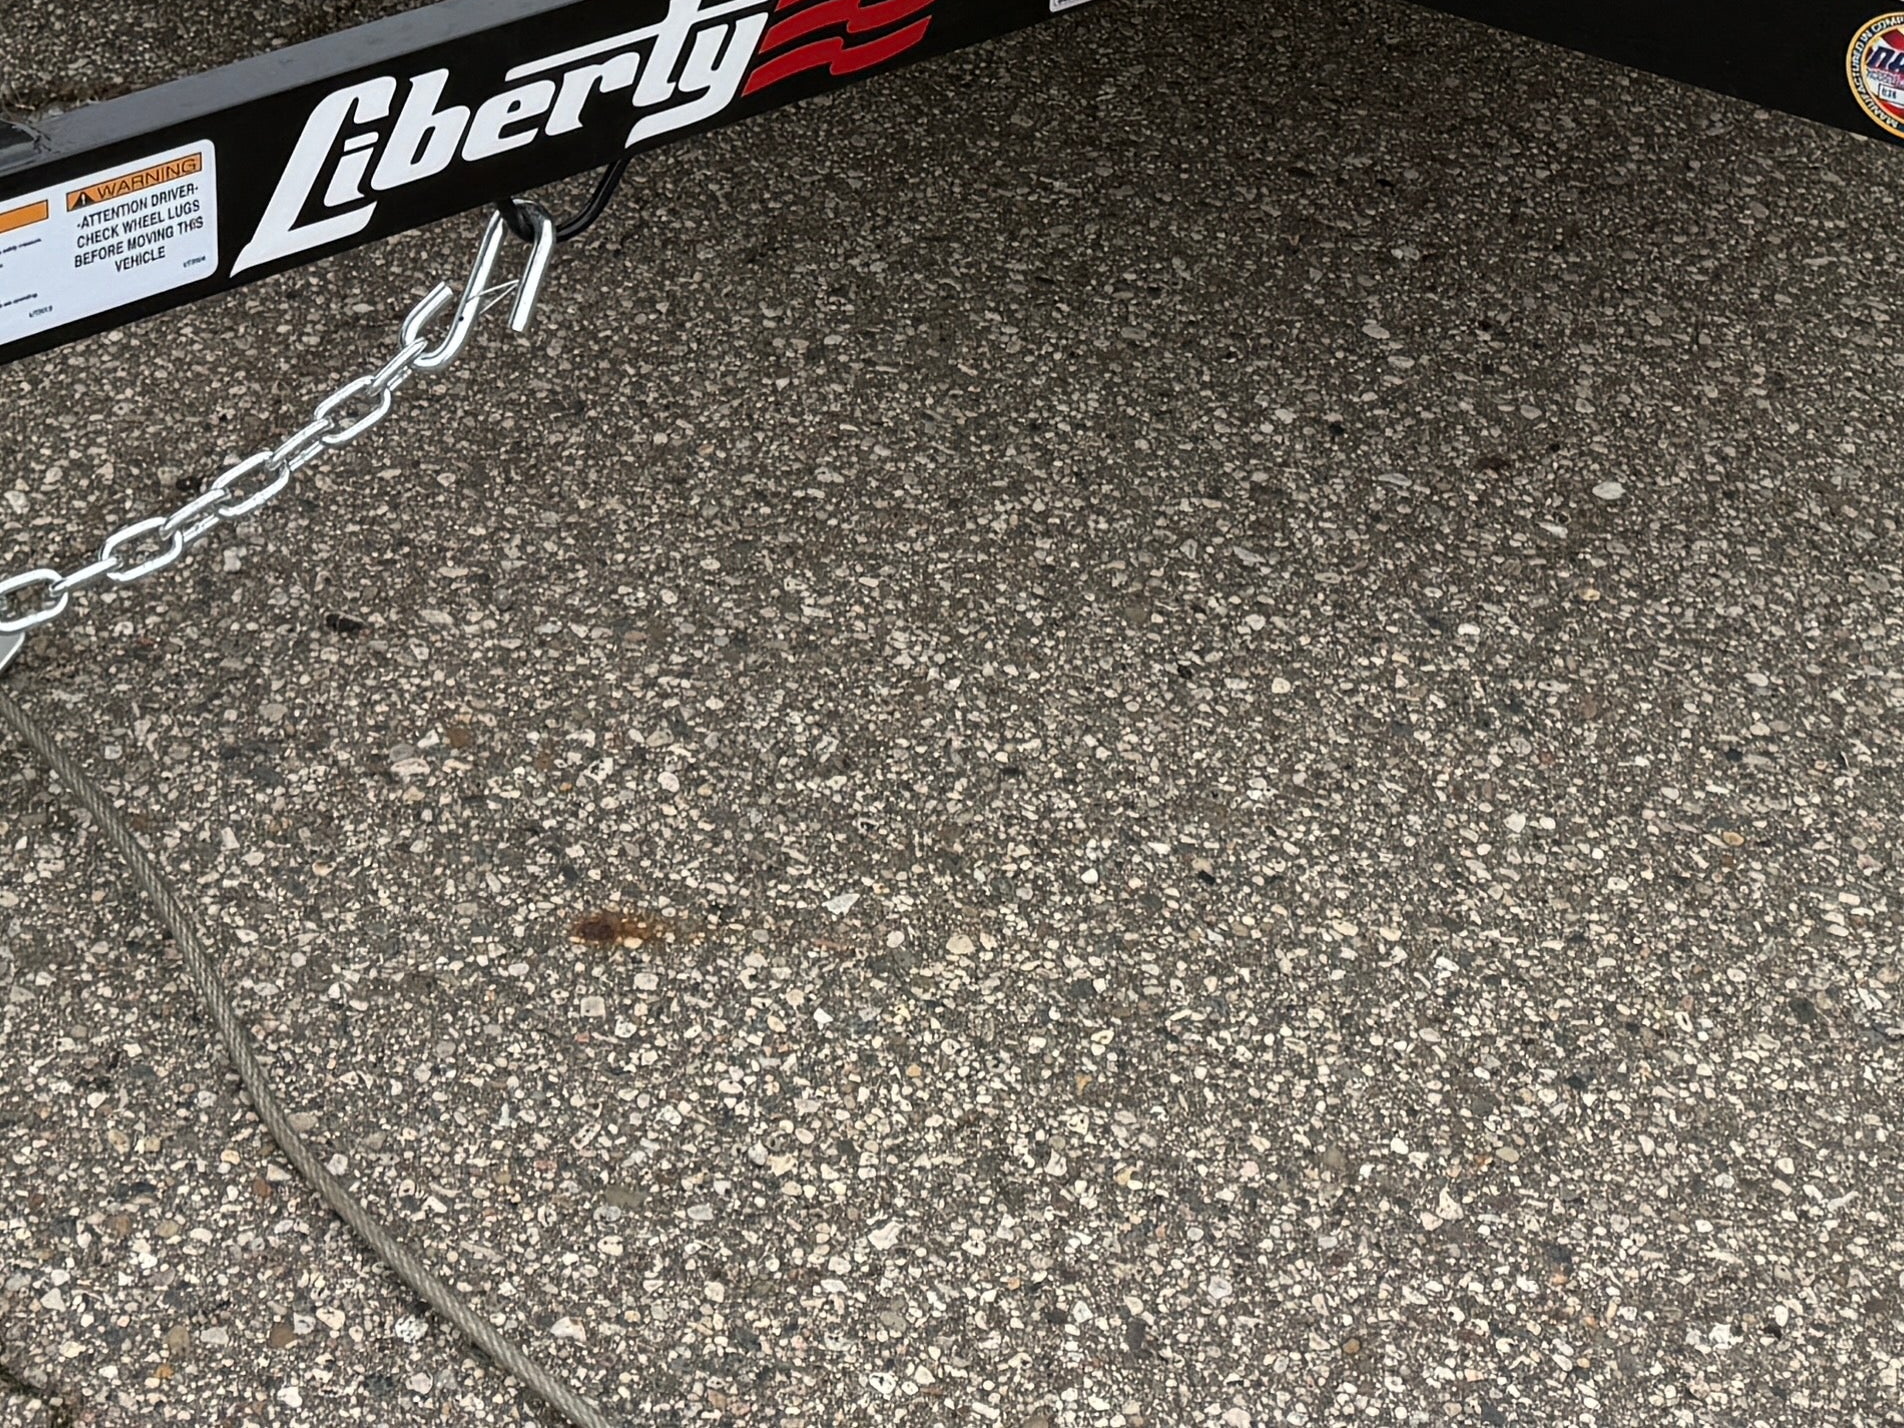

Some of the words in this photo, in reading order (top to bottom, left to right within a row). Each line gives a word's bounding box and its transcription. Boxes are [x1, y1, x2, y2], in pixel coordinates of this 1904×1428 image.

[97, 158, 196, 199] WARNING
[74, 242, 124, 268] BEFORE
[127, 226, 174, 252] MOVING
[177, 216, 204, 235] THIS
[77, 224, 119, 249] CHECK
[122, 212, 165, 234] WHEEL
[168, 199, 200, 220] LUGS
[114, 246, 166, 272] VEHICLE
